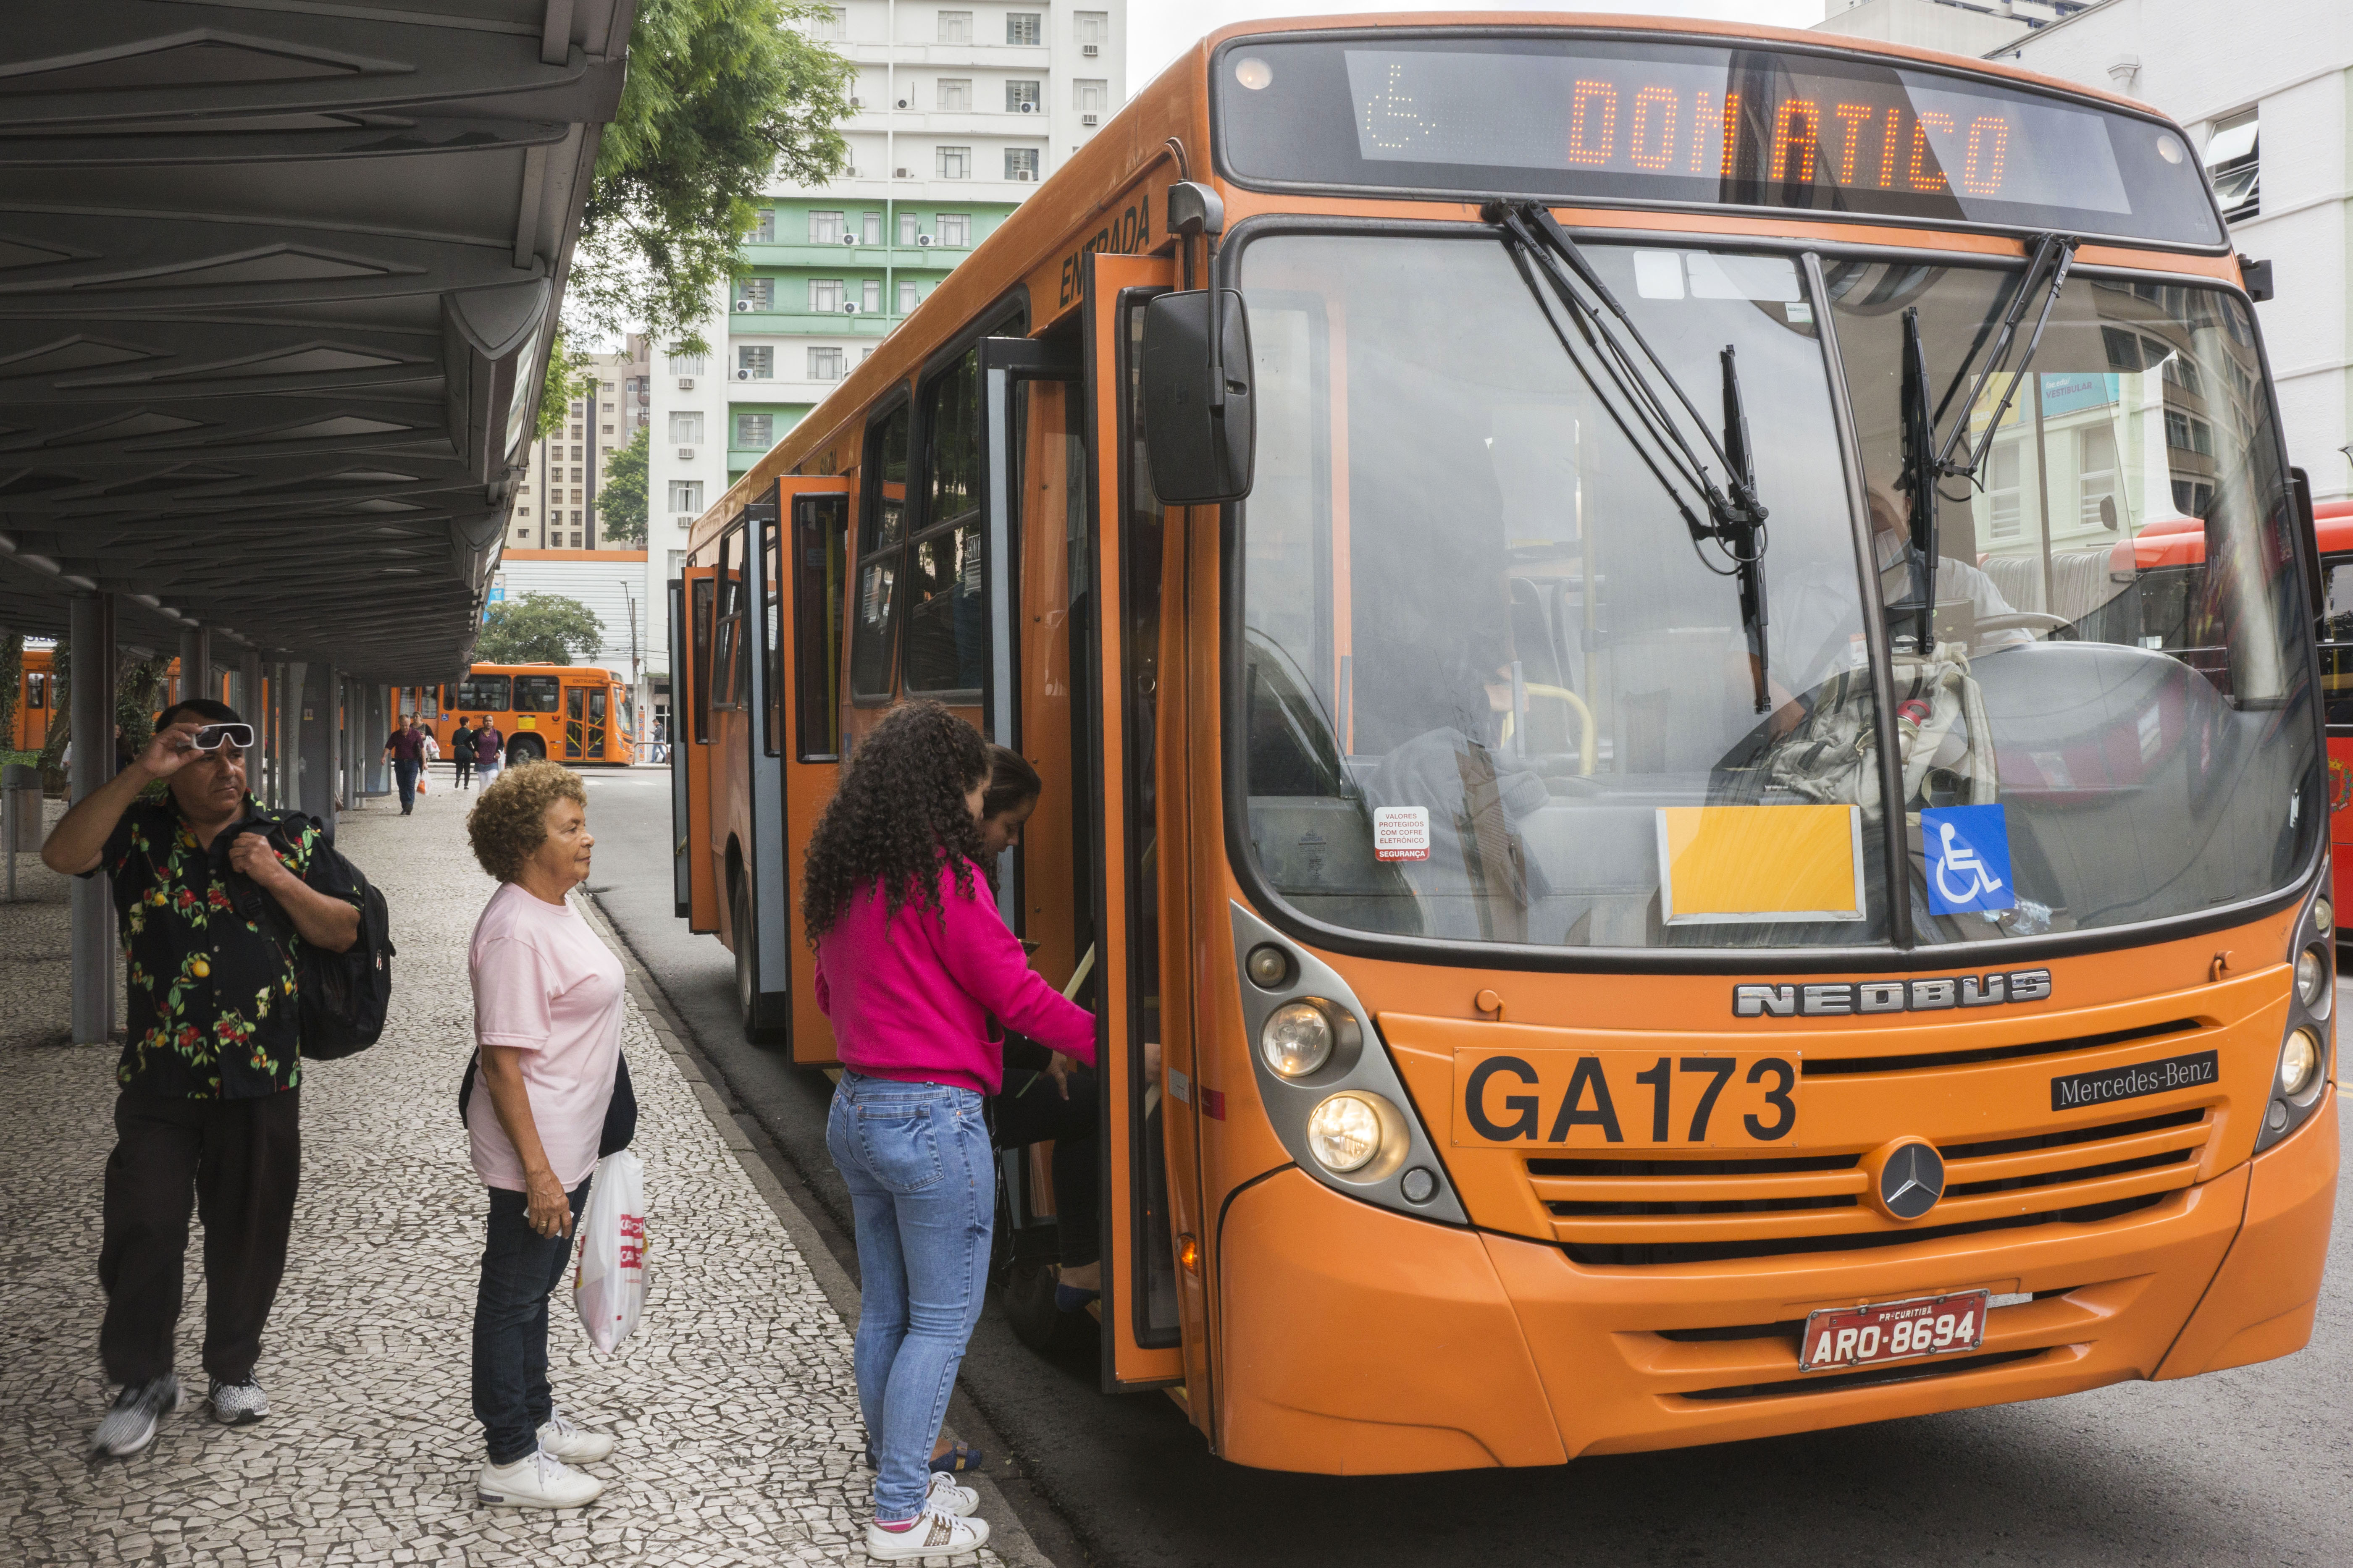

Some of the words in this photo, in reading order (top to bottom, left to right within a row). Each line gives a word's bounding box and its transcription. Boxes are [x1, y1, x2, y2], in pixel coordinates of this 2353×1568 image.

[1569, 79, 1739, 175] DOM
[1772, 99, 2009, 194] ATICO
[2045, 376, 2071, 390] fae.edu/
[2046, 381, 2093, 399] VESTIBULAR
[1735, 968, 2051, 1016] NEOBUS
[1464, 1055, 1797, 1143] GA173
[2059, 1059, 2212, 1106] Mercedes-Benz
[1879, 1306, 1932, 1322] PR-CURITIBA
